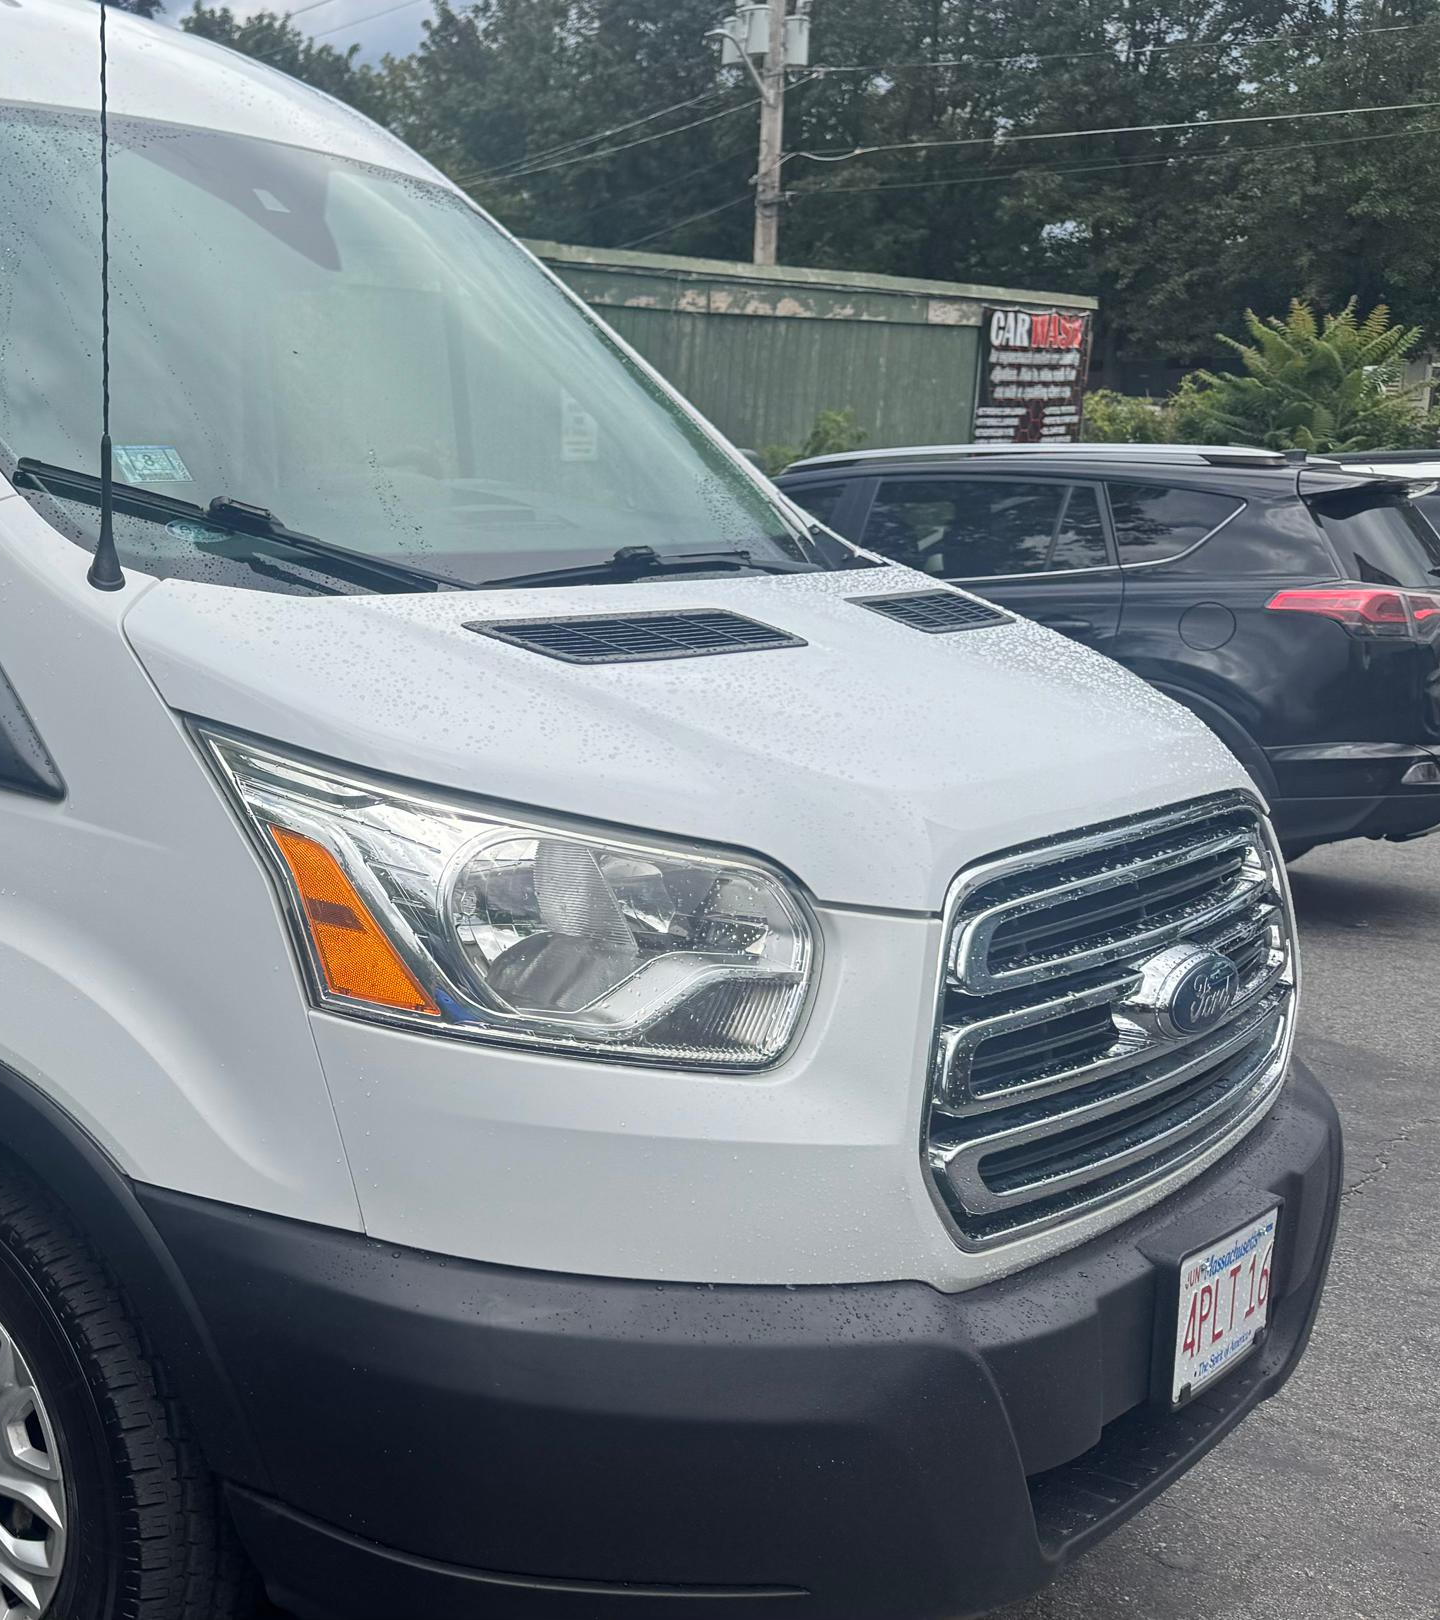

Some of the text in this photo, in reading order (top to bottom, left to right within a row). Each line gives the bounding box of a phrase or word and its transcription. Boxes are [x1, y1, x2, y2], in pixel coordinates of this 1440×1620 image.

[990, 312, 1030, 346] CAR
[1191, 975, 1230, 1023] Ford
[1185, 1266, 1200, 1290] JUN
